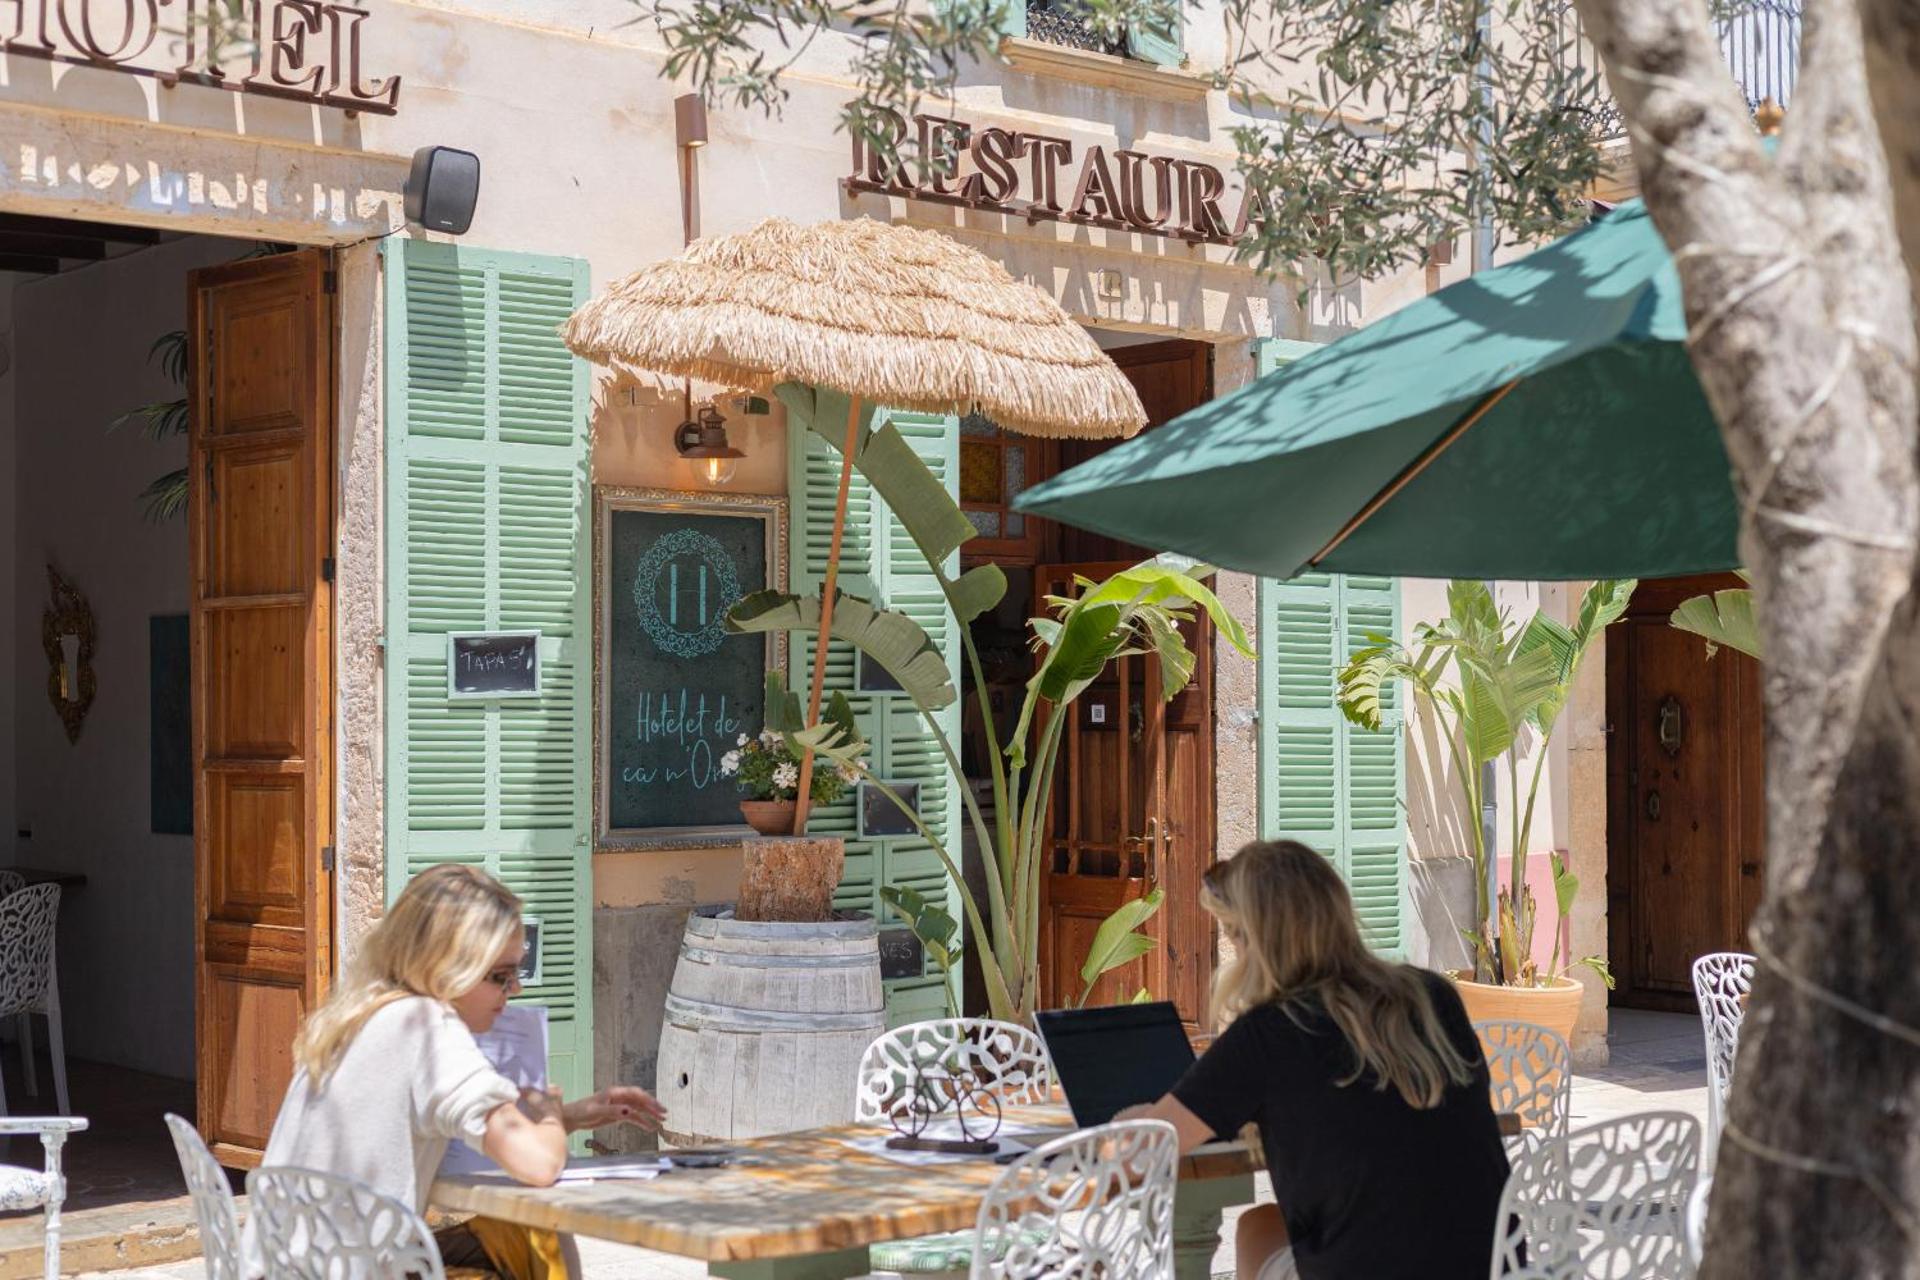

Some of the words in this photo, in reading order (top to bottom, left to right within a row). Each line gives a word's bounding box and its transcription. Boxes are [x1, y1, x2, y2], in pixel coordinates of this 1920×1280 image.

[0, 0, 401, 115] OTEL
[634, 688, 712, 746] Hotelet
[714, 694, 741, 738] de
